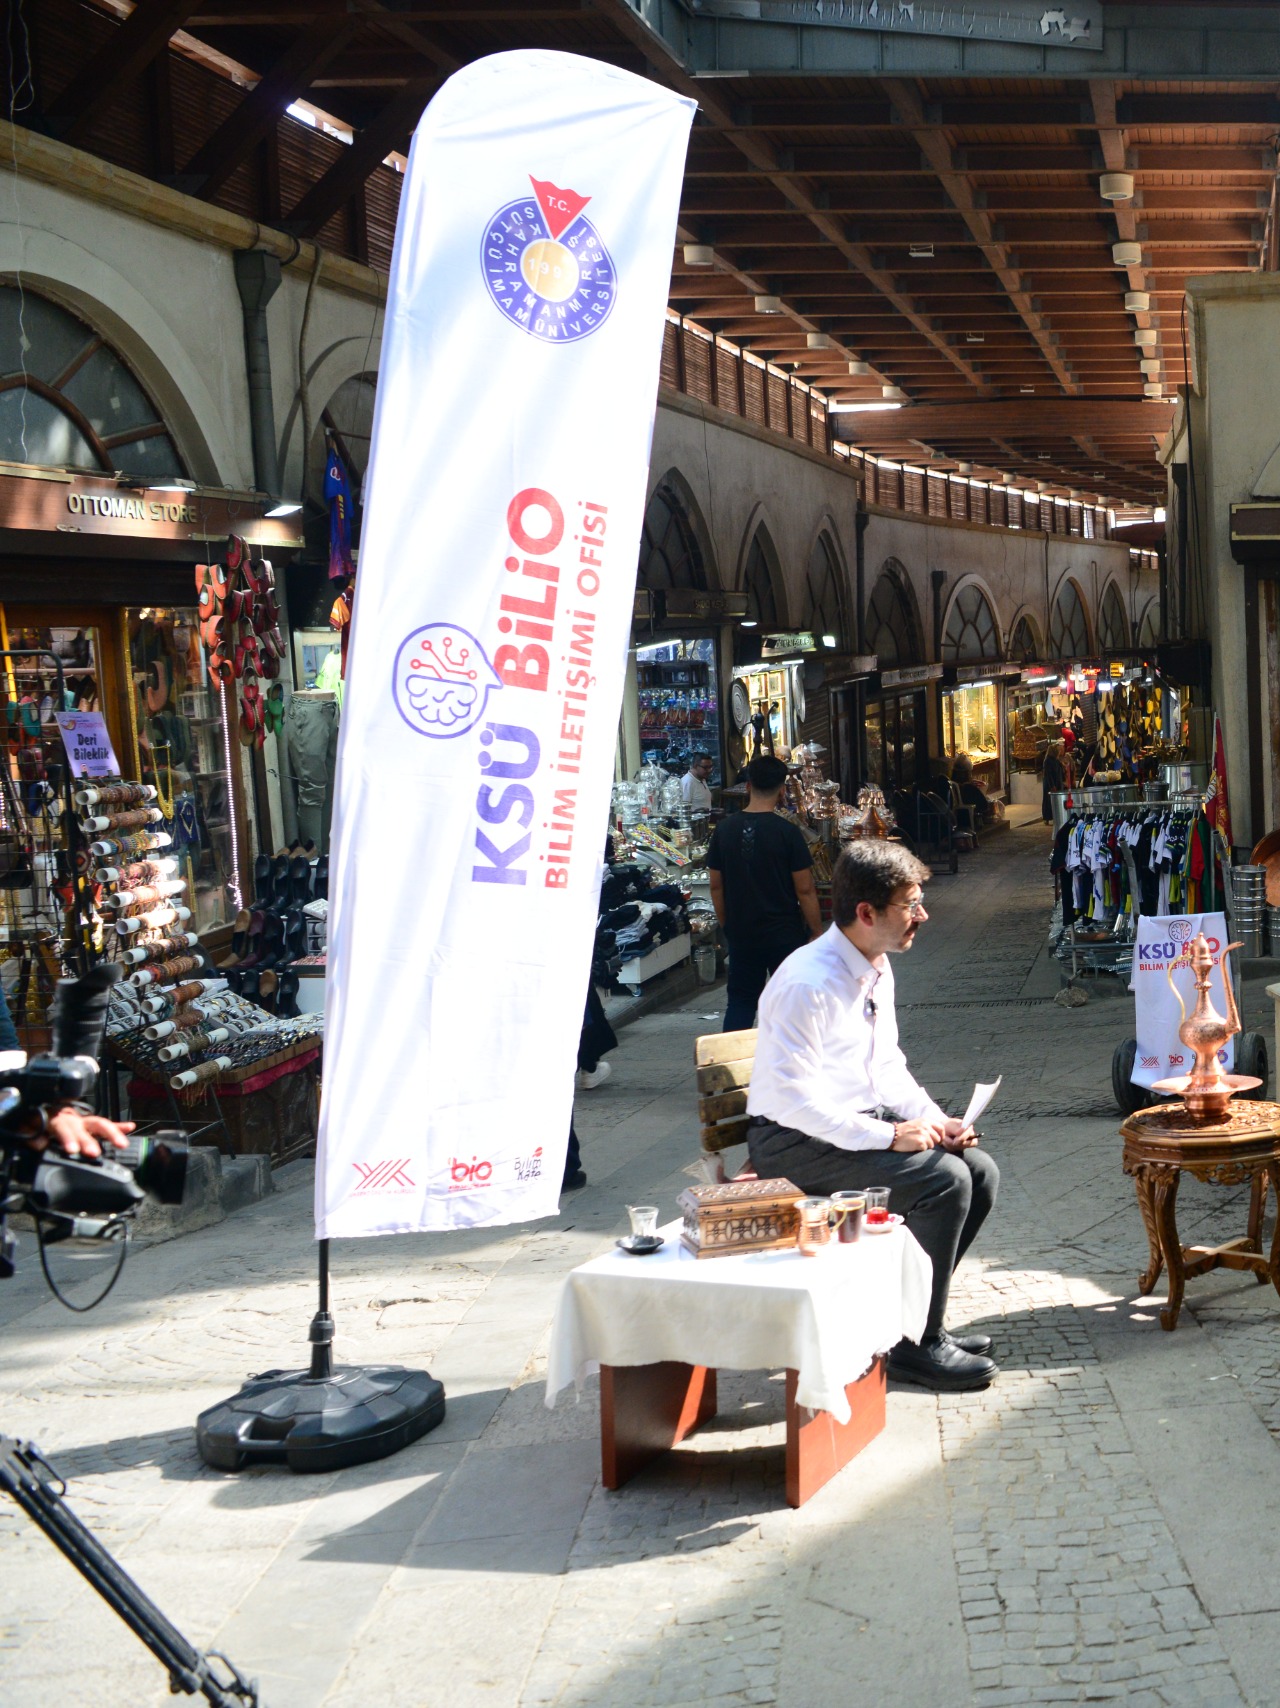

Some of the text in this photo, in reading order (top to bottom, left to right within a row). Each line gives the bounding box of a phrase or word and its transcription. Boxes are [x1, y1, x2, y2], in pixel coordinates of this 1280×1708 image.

[546, 195, 571, 213] T.C.
[68, 492, 198, 523] OTTOMAN STORE
[539, 500, 608, 889] BİLİM İLETİŞİMİ OFİSİ
[77, 733, 97, 746] Deri
[73, 747, 110, 761] Bileklik
[472, 722, 541, 886] KSÜ
[1138, 942, 1176, 960] KSÜ
[1139, 961, 1164, 971] BİLİM
